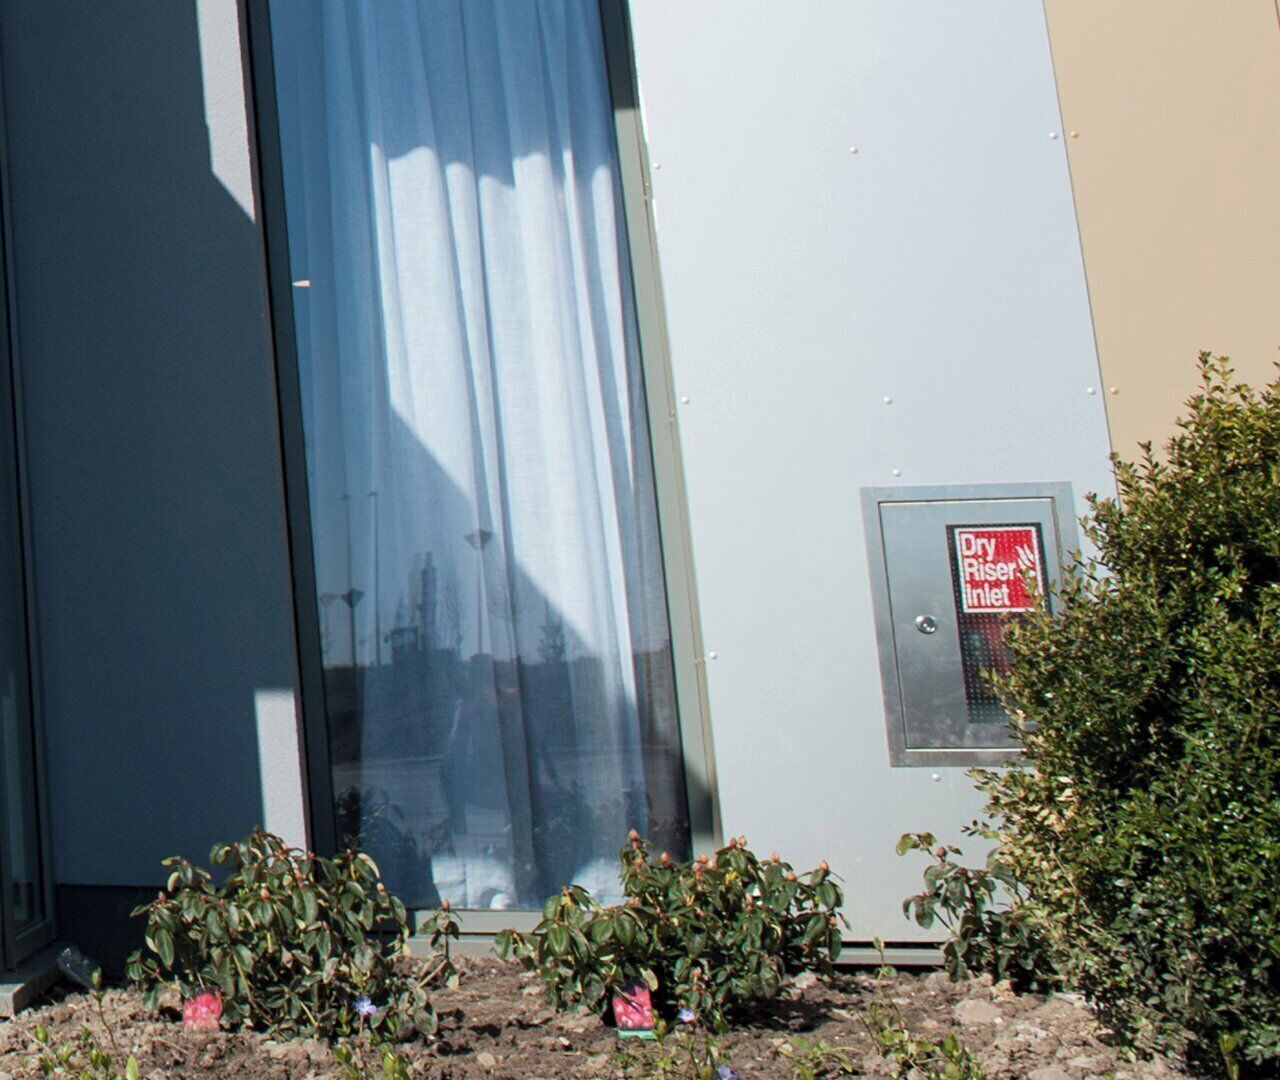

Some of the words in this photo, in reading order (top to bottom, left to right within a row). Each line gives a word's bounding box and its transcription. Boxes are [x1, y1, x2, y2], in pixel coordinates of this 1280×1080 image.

[960, 533, 996, 561] Dry
[964, 557, 1017, 581] Riser
[966, 582, 1011, 607] Inlet
